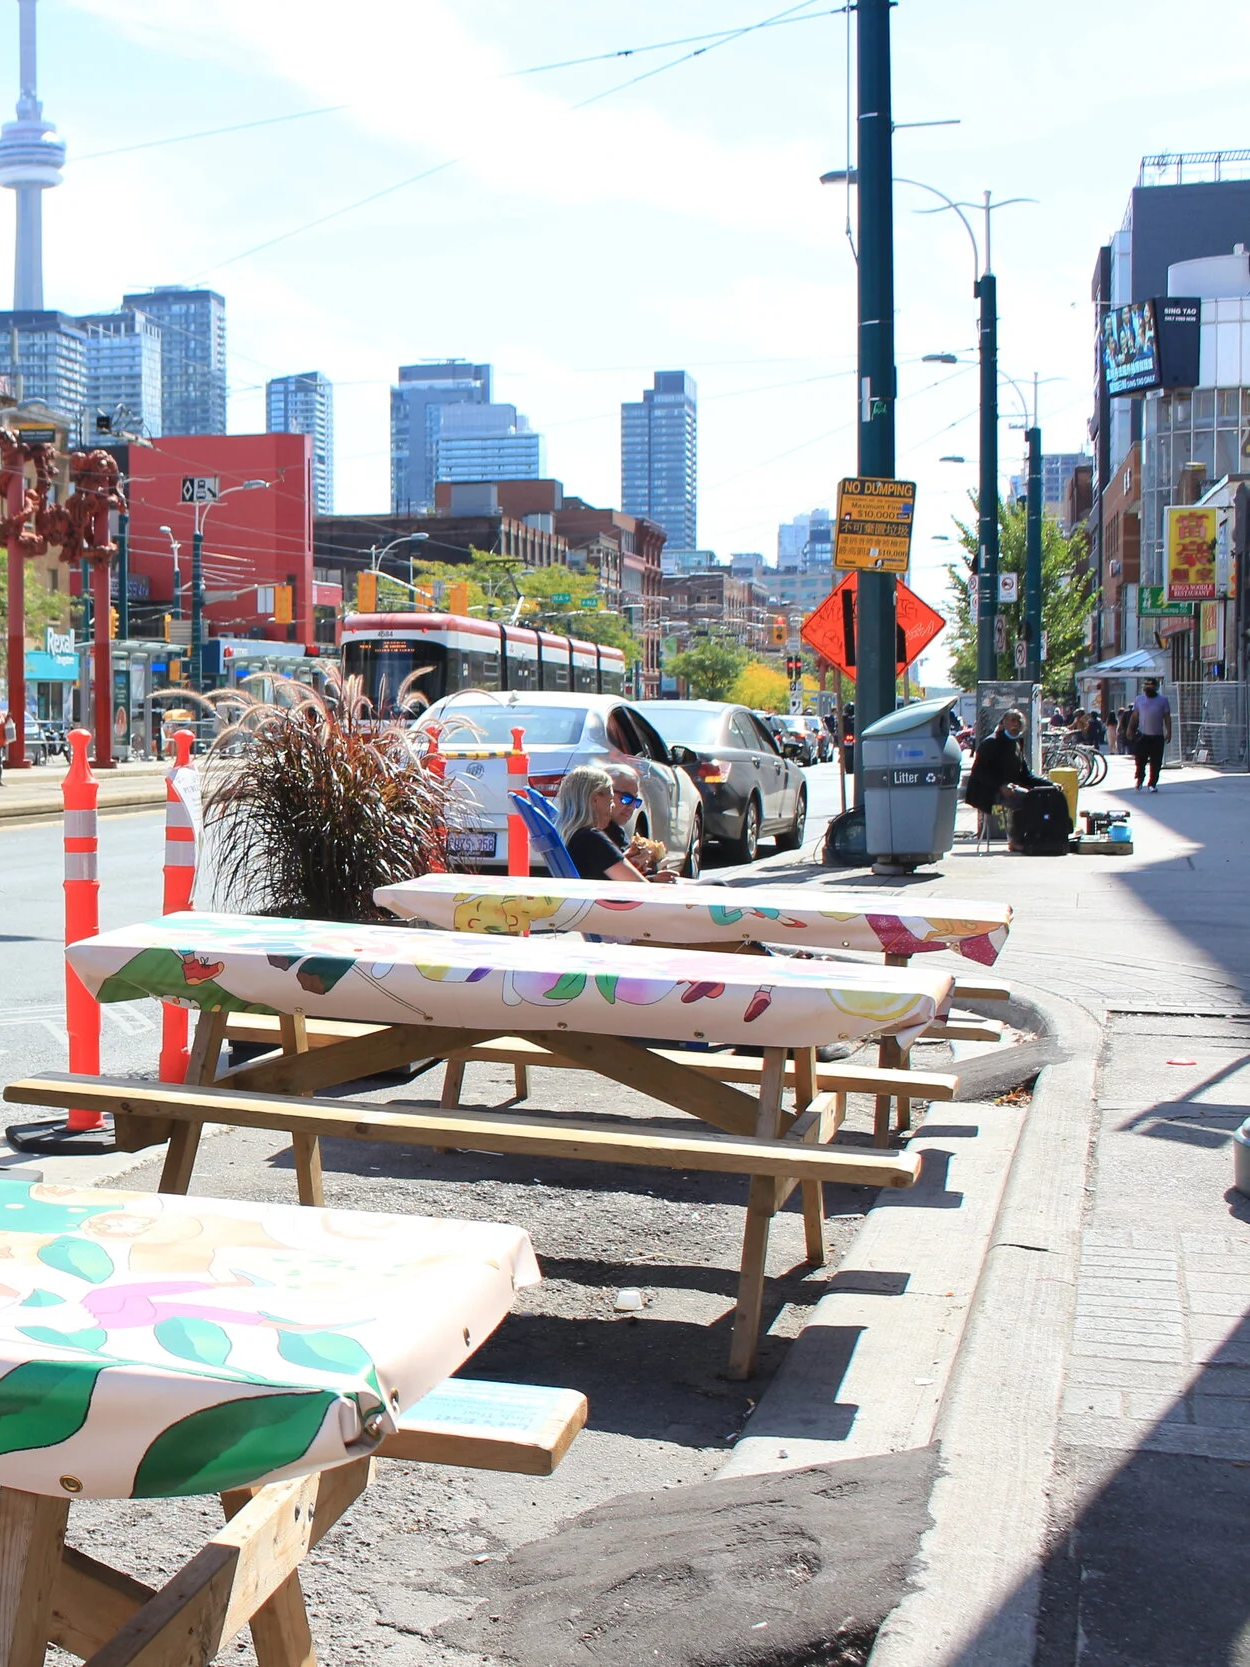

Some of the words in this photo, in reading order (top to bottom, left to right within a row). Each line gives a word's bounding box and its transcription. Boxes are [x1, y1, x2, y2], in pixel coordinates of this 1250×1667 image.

[844, 481, 860, 493] NO
[864, 481, 913, 497] DUMPING
[857, 509, 896, 520] $10,000
[47, 627, 75, 656] Rexall
[893, 771, 919, 784] Litter
